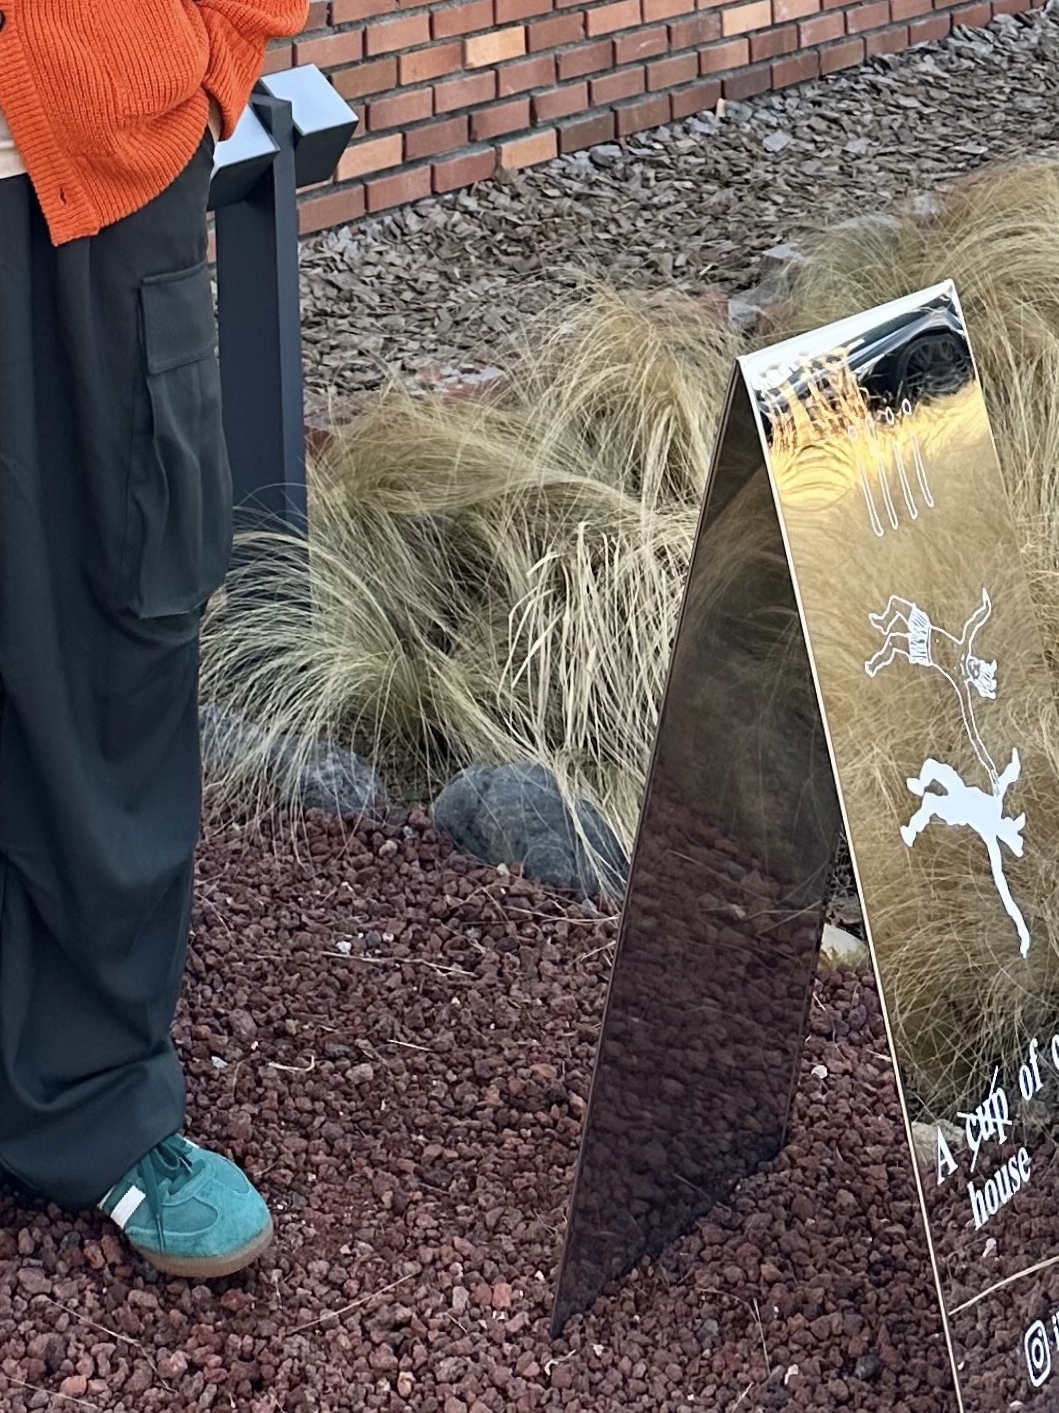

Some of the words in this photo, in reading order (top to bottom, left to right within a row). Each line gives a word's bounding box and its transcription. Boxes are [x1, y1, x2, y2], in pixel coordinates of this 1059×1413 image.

[936, 1126, 960, 1186] A
[965, 1086, 1010, 1152] cup
[1019, 1038, 1044, 1102] of
[968, 1146, 1032, 1231] house
